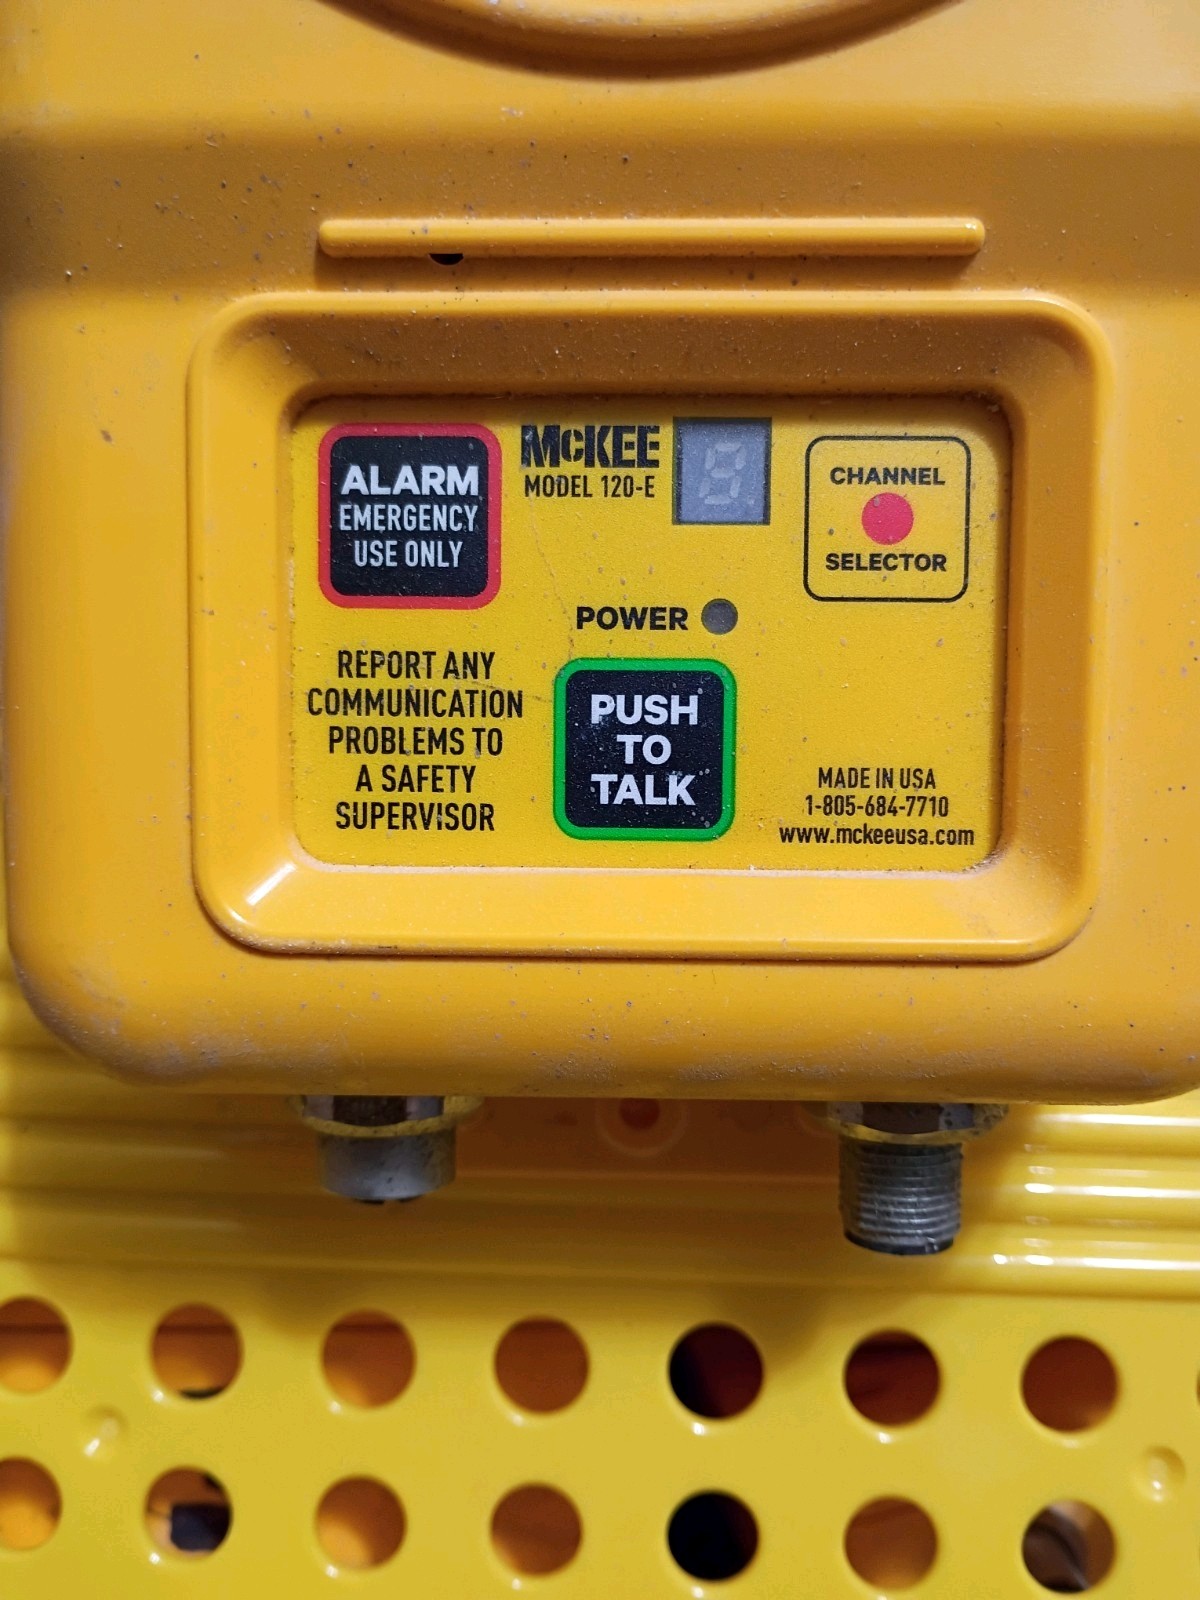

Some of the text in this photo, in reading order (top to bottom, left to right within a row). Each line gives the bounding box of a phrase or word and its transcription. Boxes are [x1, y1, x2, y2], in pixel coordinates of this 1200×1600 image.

[341, 465, 479, 496] ALARM
[524, 474, 655, 499] MODEL 120-E
[830, 467, 946, 486] CHANNEL
[340, 504, 478, 532] EMERGENCY
[354, 540, 463, 568] USE ONLY
[825, 552, 947, 572] SELECTOR
[576, 606, 689, 631] POWER
[337, 650, 496, 680] REPORT ANY
[308, 688, 523, 719] COMMUNICATION
[591, 694, 699, 725] PUSH
[329, 726, 503, 756] PROBLEMS TO
[616, 735, 672, 765] TO
[355, 764, 476, 793] A SAFETY
[591, 774, 696, 806] TALK
[818, 767, 936, 789] MADE IN USA
[336, 801, 495, 832] SUPERVISOR
[805, 795, 949, 817] 1-805-684-7710
[779, 823, 975, 846] www.mckeeusa.com
